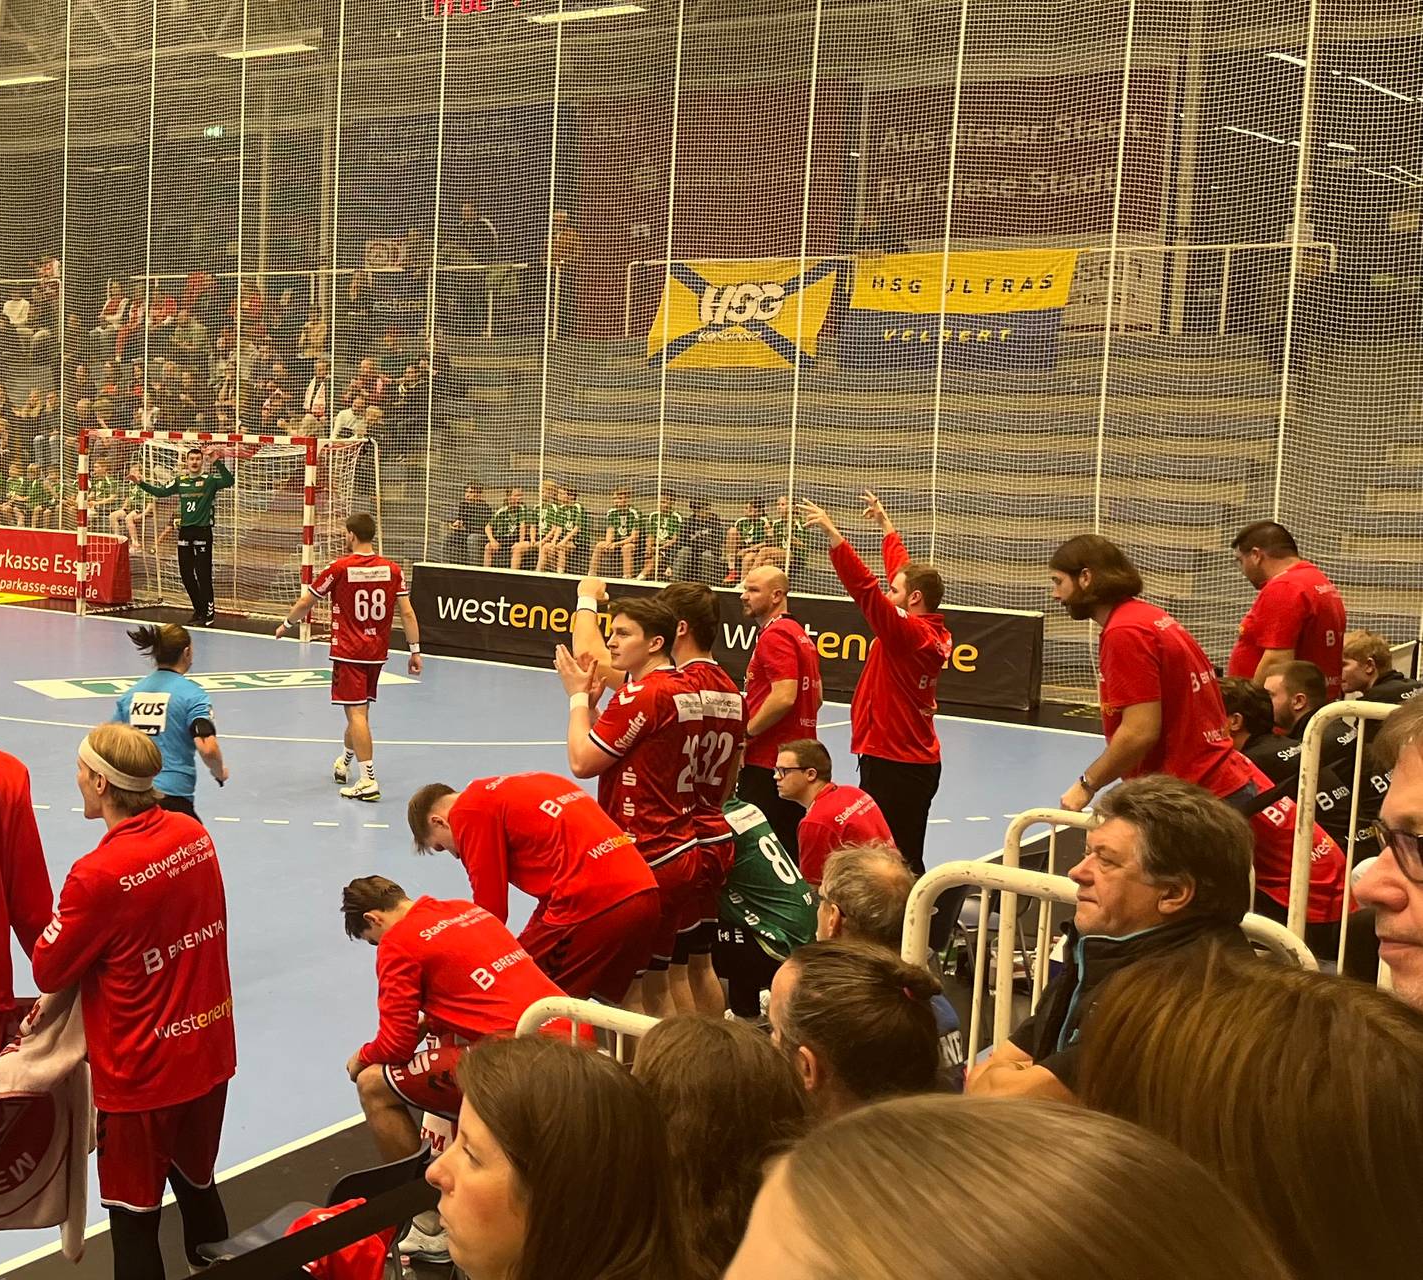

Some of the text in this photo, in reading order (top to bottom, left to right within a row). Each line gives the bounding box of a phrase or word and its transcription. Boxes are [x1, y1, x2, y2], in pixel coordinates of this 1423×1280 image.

[870, 275, 922, 294] HSG
[699, 282, 786, 325] HSG
[354, 588, 386, 622] 68
